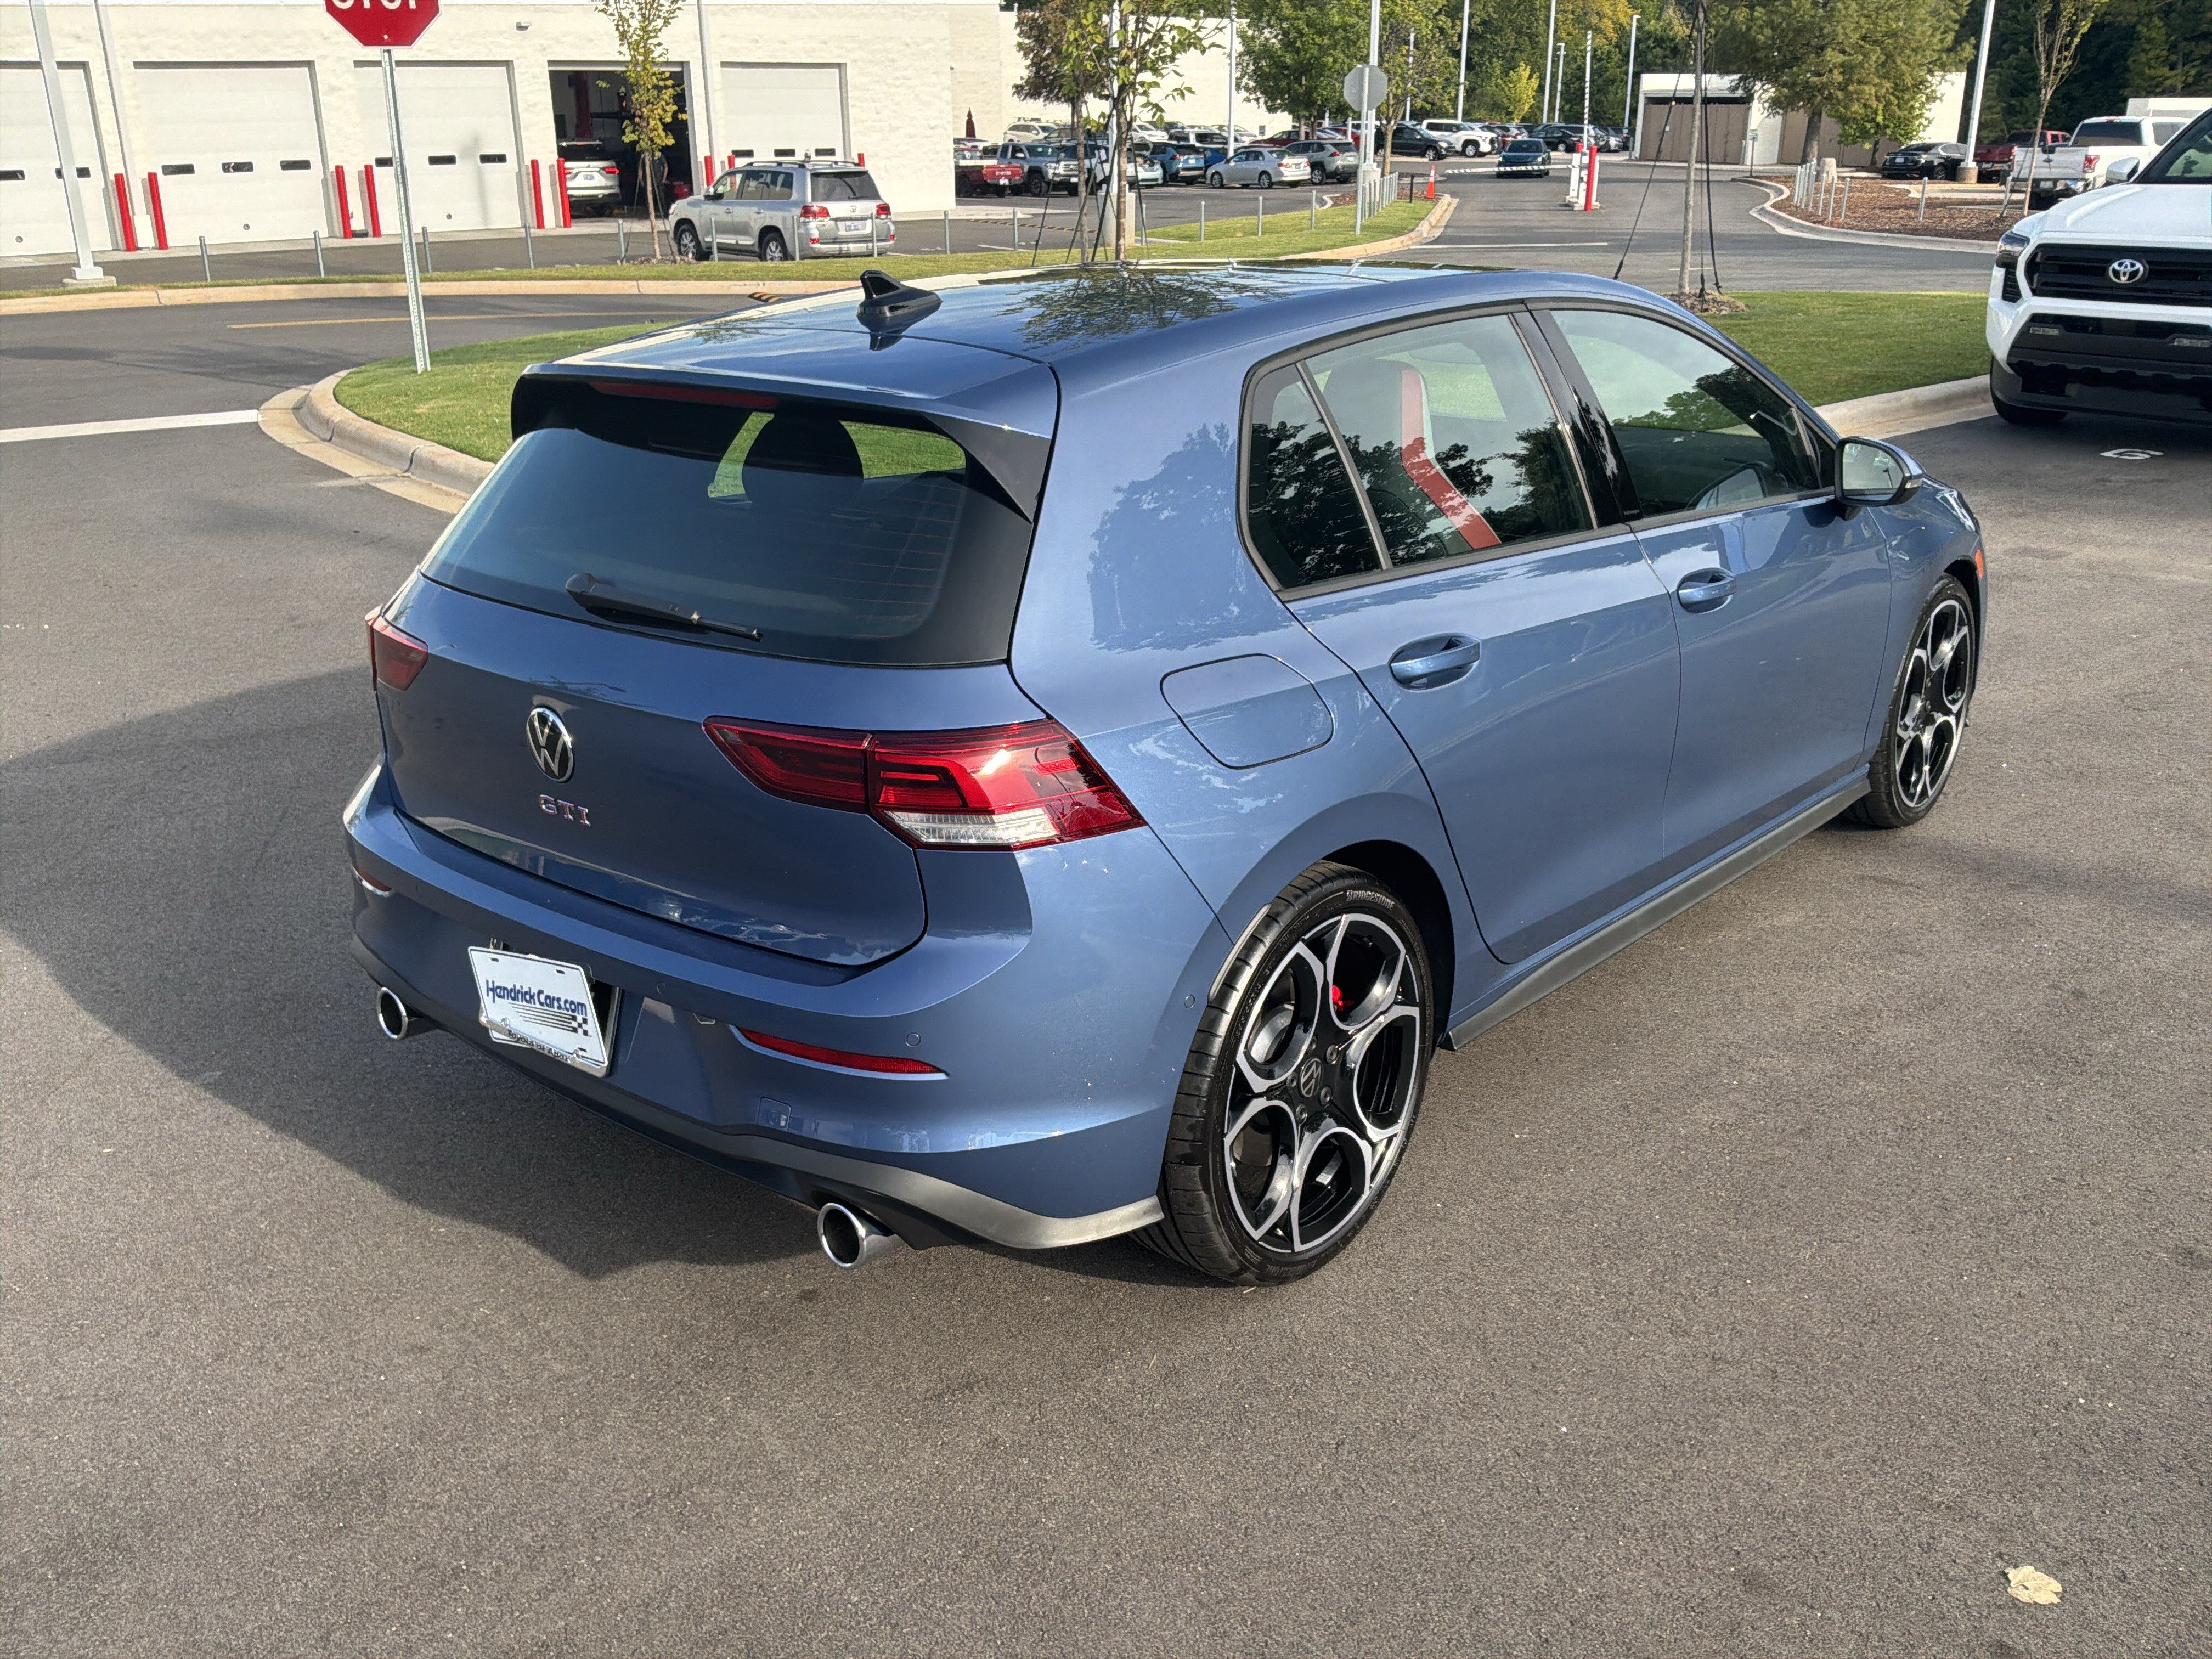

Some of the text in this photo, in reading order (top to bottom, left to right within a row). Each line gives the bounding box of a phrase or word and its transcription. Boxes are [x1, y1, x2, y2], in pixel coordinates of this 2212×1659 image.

[539, 794, 591, 827] GTI
[1346, 889, 1395, 911] BRIDGESTONE
[507, 1029, 535, 1047] Toyota
